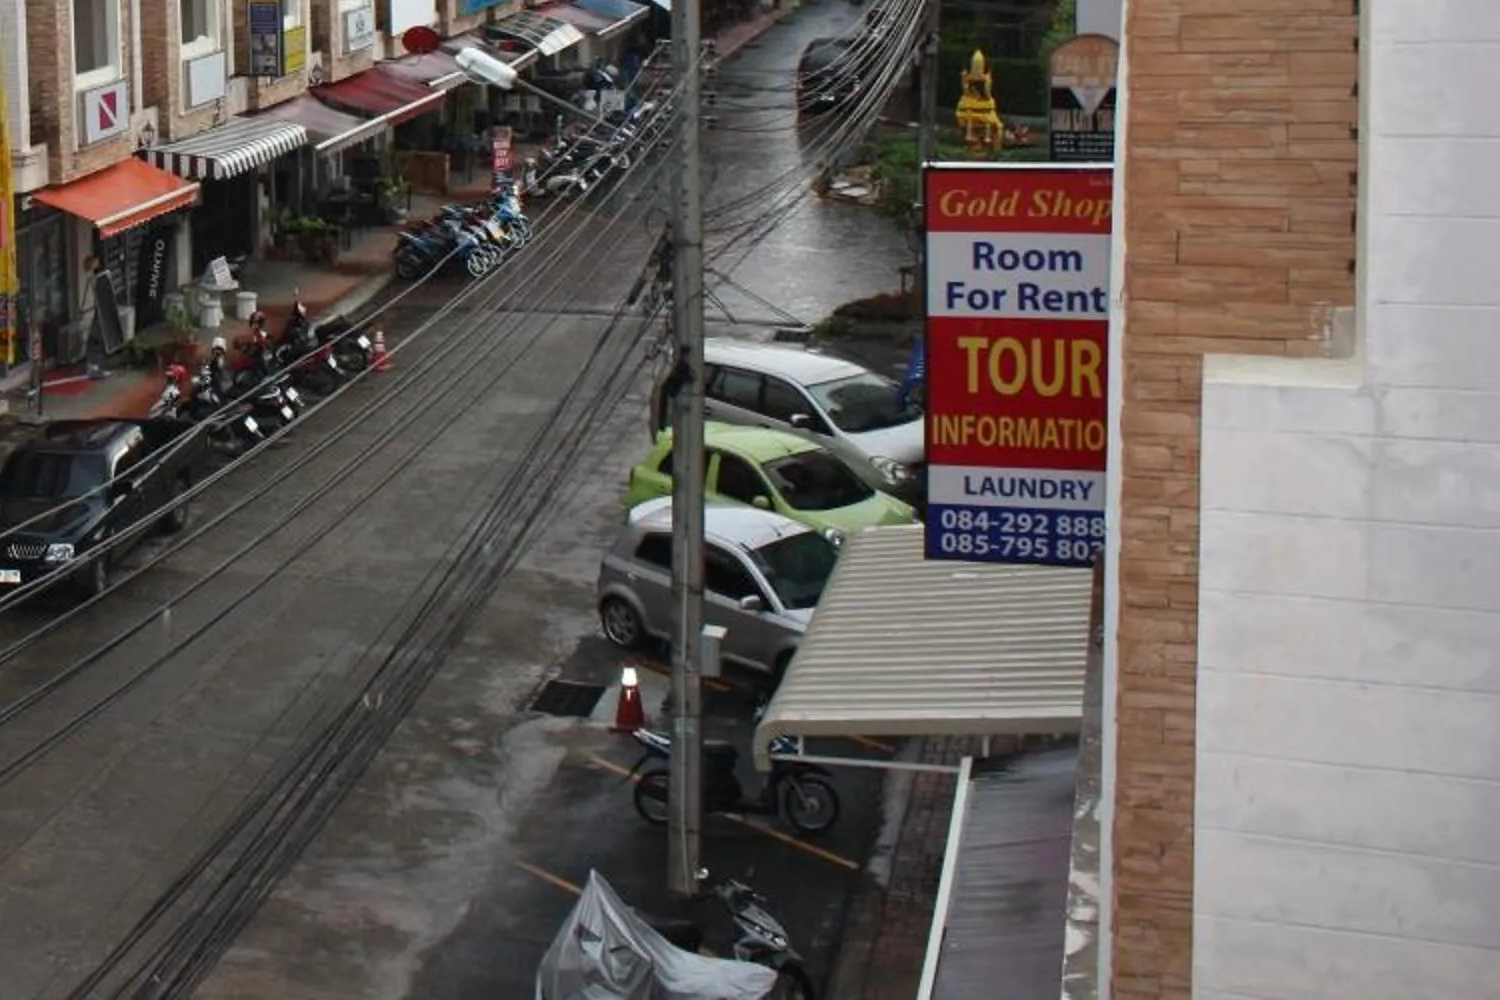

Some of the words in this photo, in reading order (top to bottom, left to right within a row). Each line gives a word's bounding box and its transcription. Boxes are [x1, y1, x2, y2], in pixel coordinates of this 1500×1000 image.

[939, 189, 1021, 218] Gold
[1028, 189, 1112, 226] Shop
[149, 239, 165, 298] SUUNTO
[972, 241, 1083, 272] Room
[946, 281, 1007, 311] For
[1017, 282, 1107, 313] Rent
[957, 335, 1103, 398] TOUR
[932, 414, 1105, 451] INFORMATIO
[964, 475, 1096, 501] LAUNDRY
[941, 509, 1050, 536] 084-292
[941, 532, 1050, 558] 085-795
